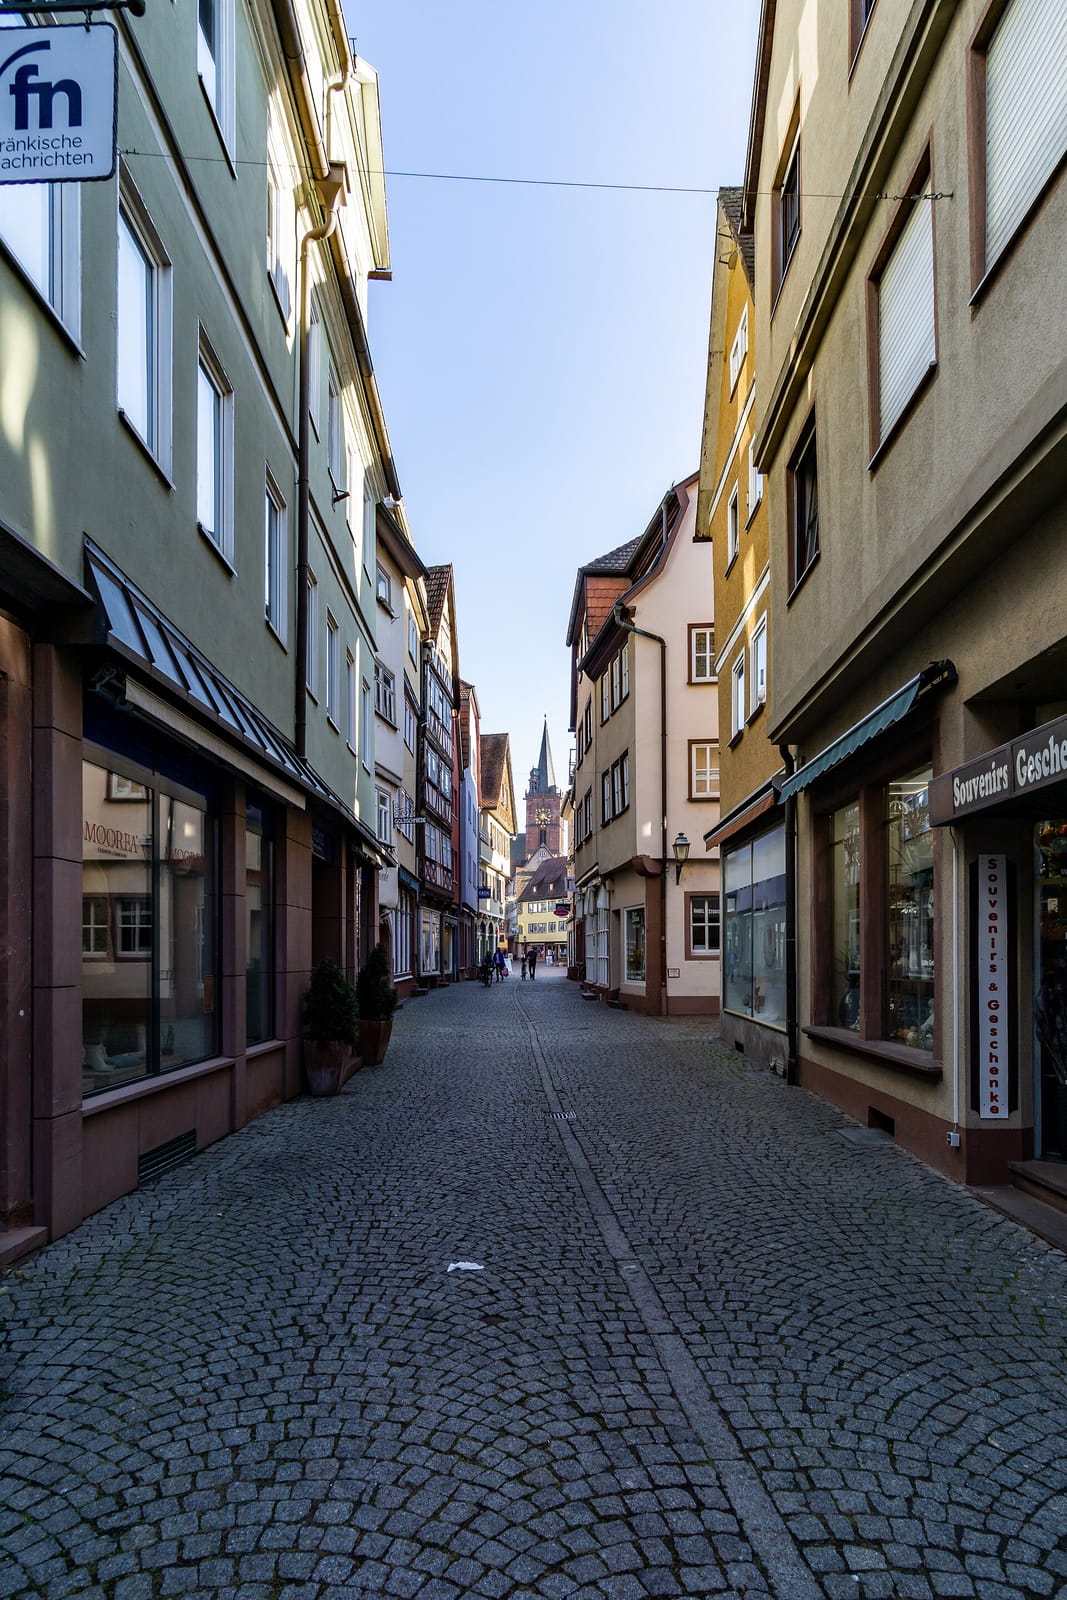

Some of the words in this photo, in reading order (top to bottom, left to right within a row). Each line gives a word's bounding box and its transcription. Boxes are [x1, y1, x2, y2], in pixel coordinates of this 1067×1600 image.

[9, 64, 82, 130] fn
[0, 134, 82, 152] ränkische
[1, 151, 94, 170] achrichten
[953, 761, 1009, 807] Souvenirs
[1016, 735, 1067, 787] Gesche
[84, 821, 138, 853] MOOREA
[987, 858, 999, 974] Souvenirs
[988, 982, 999, 992] &
[987, 999, 1000, 1114] Geschenke
